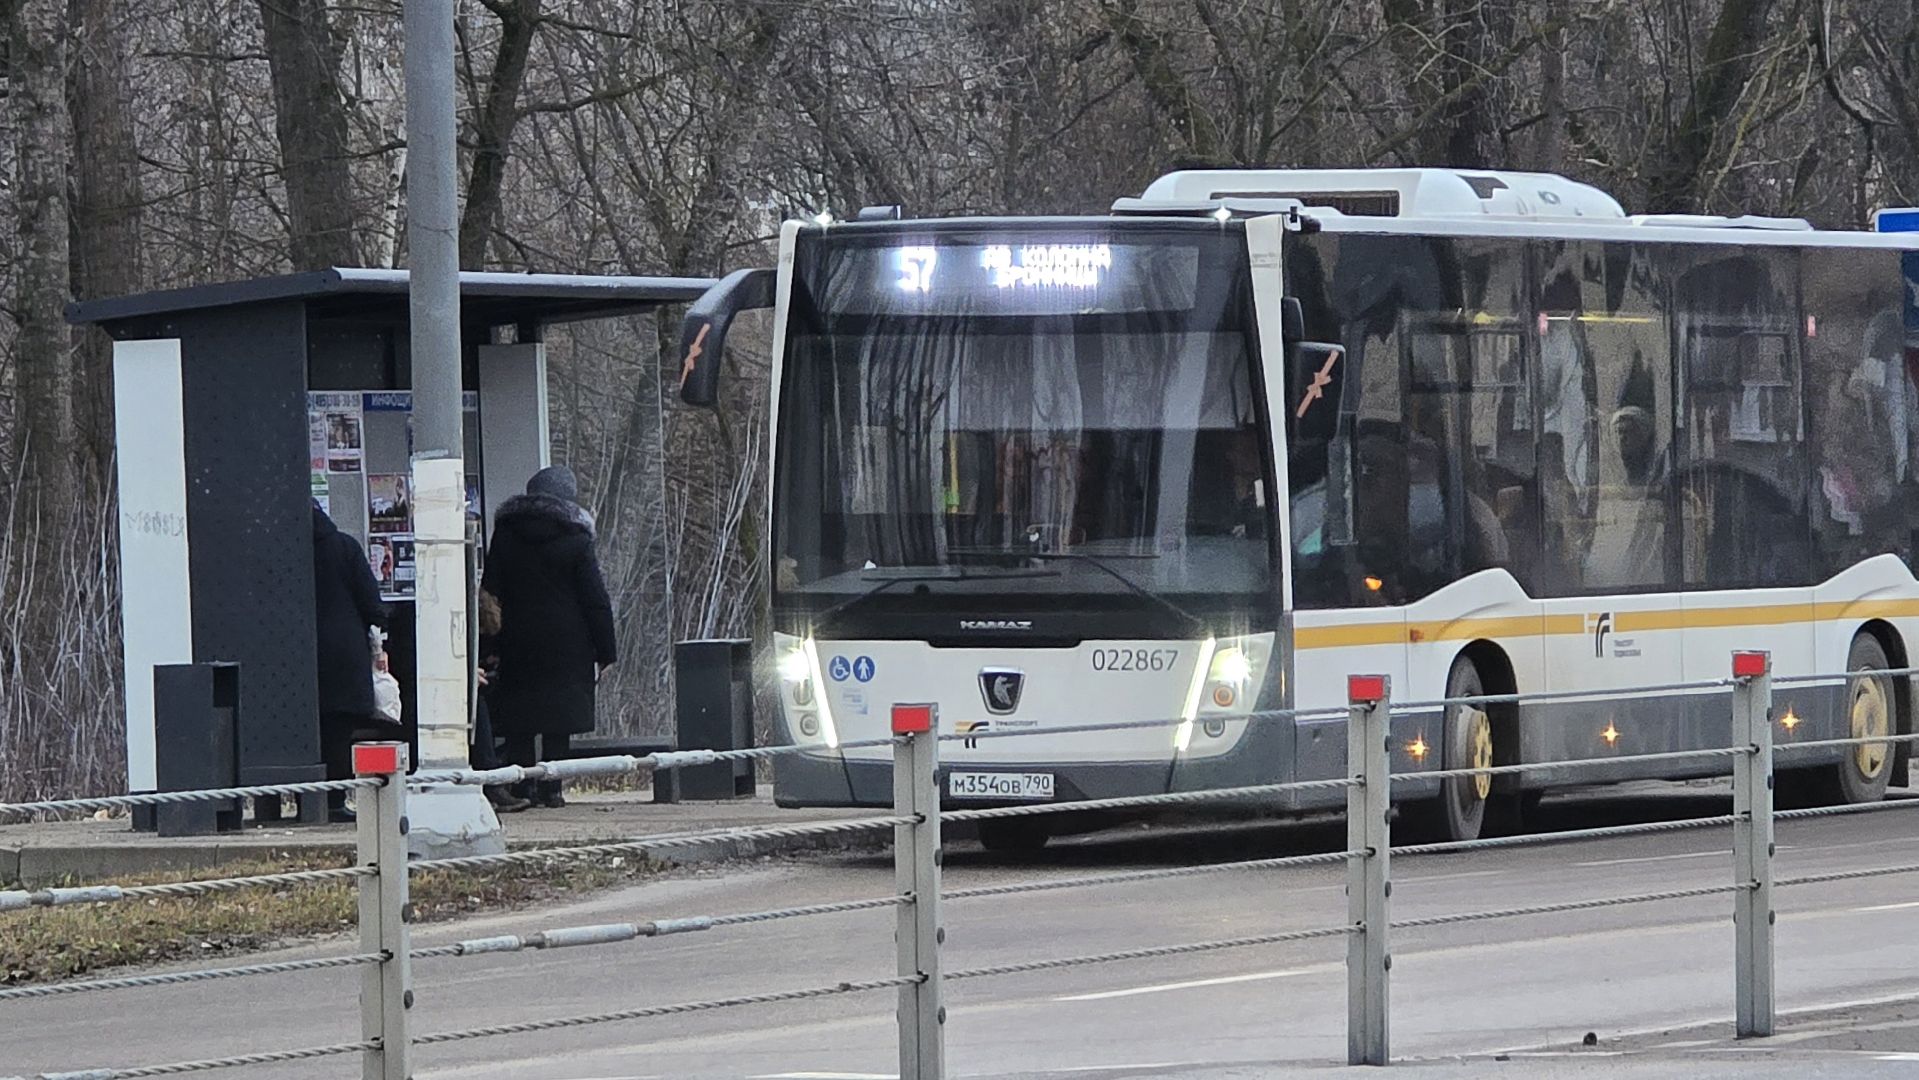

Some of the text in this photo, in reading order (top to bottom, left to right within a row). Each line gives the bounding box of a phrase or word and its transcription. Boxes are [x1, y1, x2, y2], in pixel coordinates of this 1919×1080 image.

[896, 246, 937, 293] 57
[371, 394, 412, 408] ИНФОЩИ
[1092, 648, 1178, 671] 022867
[954, 775, 1050, 794] М354ОВ 790
